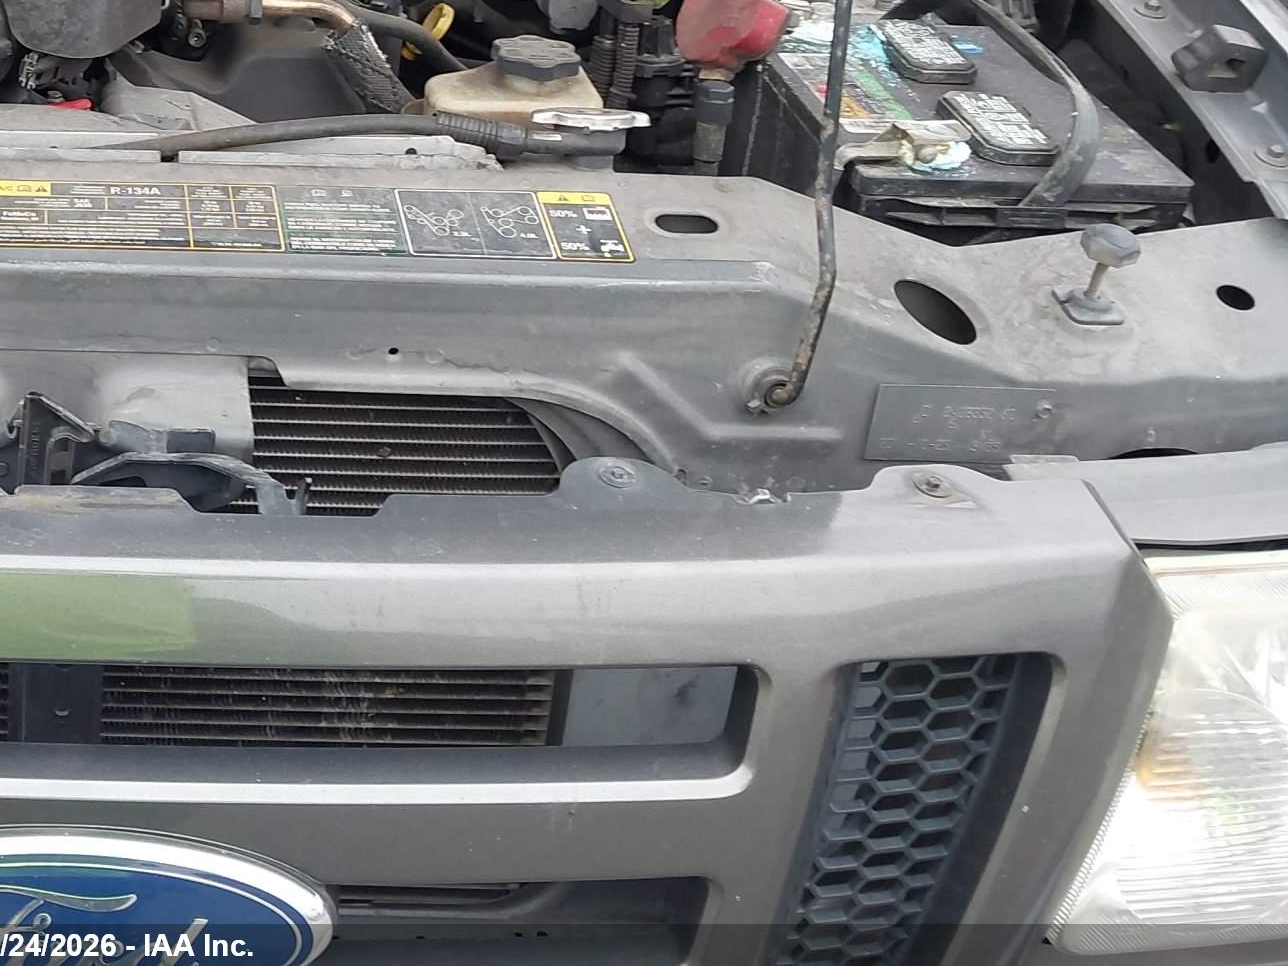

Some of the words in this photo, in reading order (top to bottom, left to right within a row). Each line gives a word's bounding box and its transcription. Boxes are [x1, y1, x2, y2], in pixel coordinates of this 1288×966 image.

[110, 186, 161, 195] R-134A
[549, 209, 579, 219] 50%
[560, 242, 591, 251] 50%
